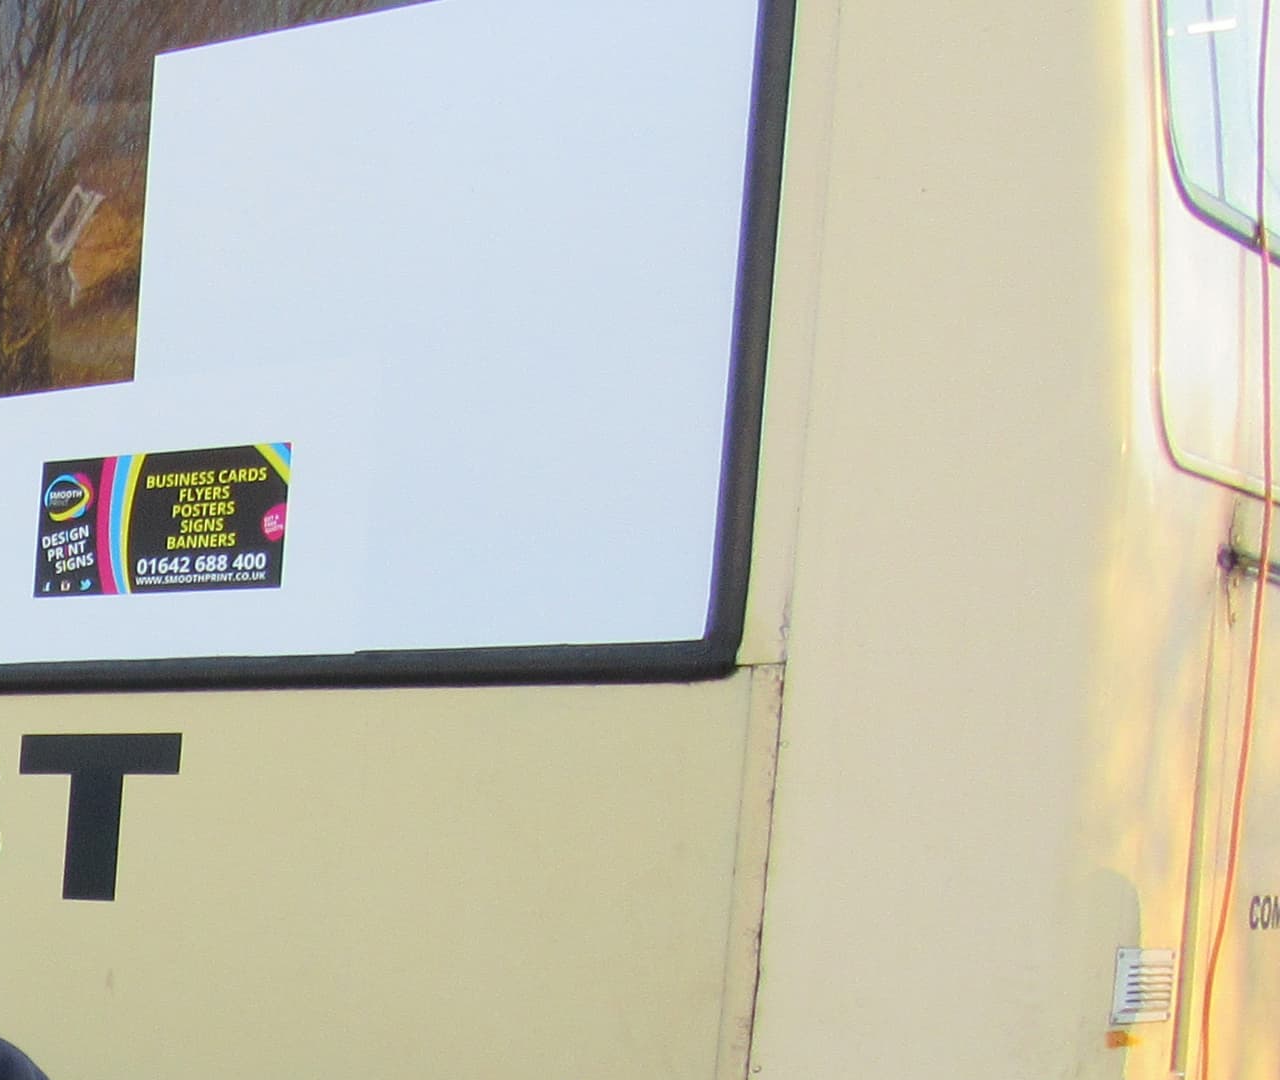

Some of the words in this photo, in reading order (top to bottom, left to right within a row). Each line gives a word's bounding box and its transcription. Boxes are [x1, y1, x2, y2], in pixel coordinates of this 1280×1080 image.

[146, 471, 215, 489] BUSINESS
[218, 467, 268, 484] CARDS
[179, 486, 231, 502] FLYERS
[172, 501, 235, 518] POSTERS
[180, 518, 224, 533] SIGNS
[42, 525, 90, 549] DESIGN
[167, 533, 236, 550] BANNERS
[47, 540, 87, 562] PRINT
[55, 552, 94, 575] SIGNS
[137, 556, 190, 575] 01642
[194, 554, 228, 573] 688
[232, 553, 267, 570] 400
[135, 571, 266, 585] WWW.SMOOTHPRINT.CO.UK
